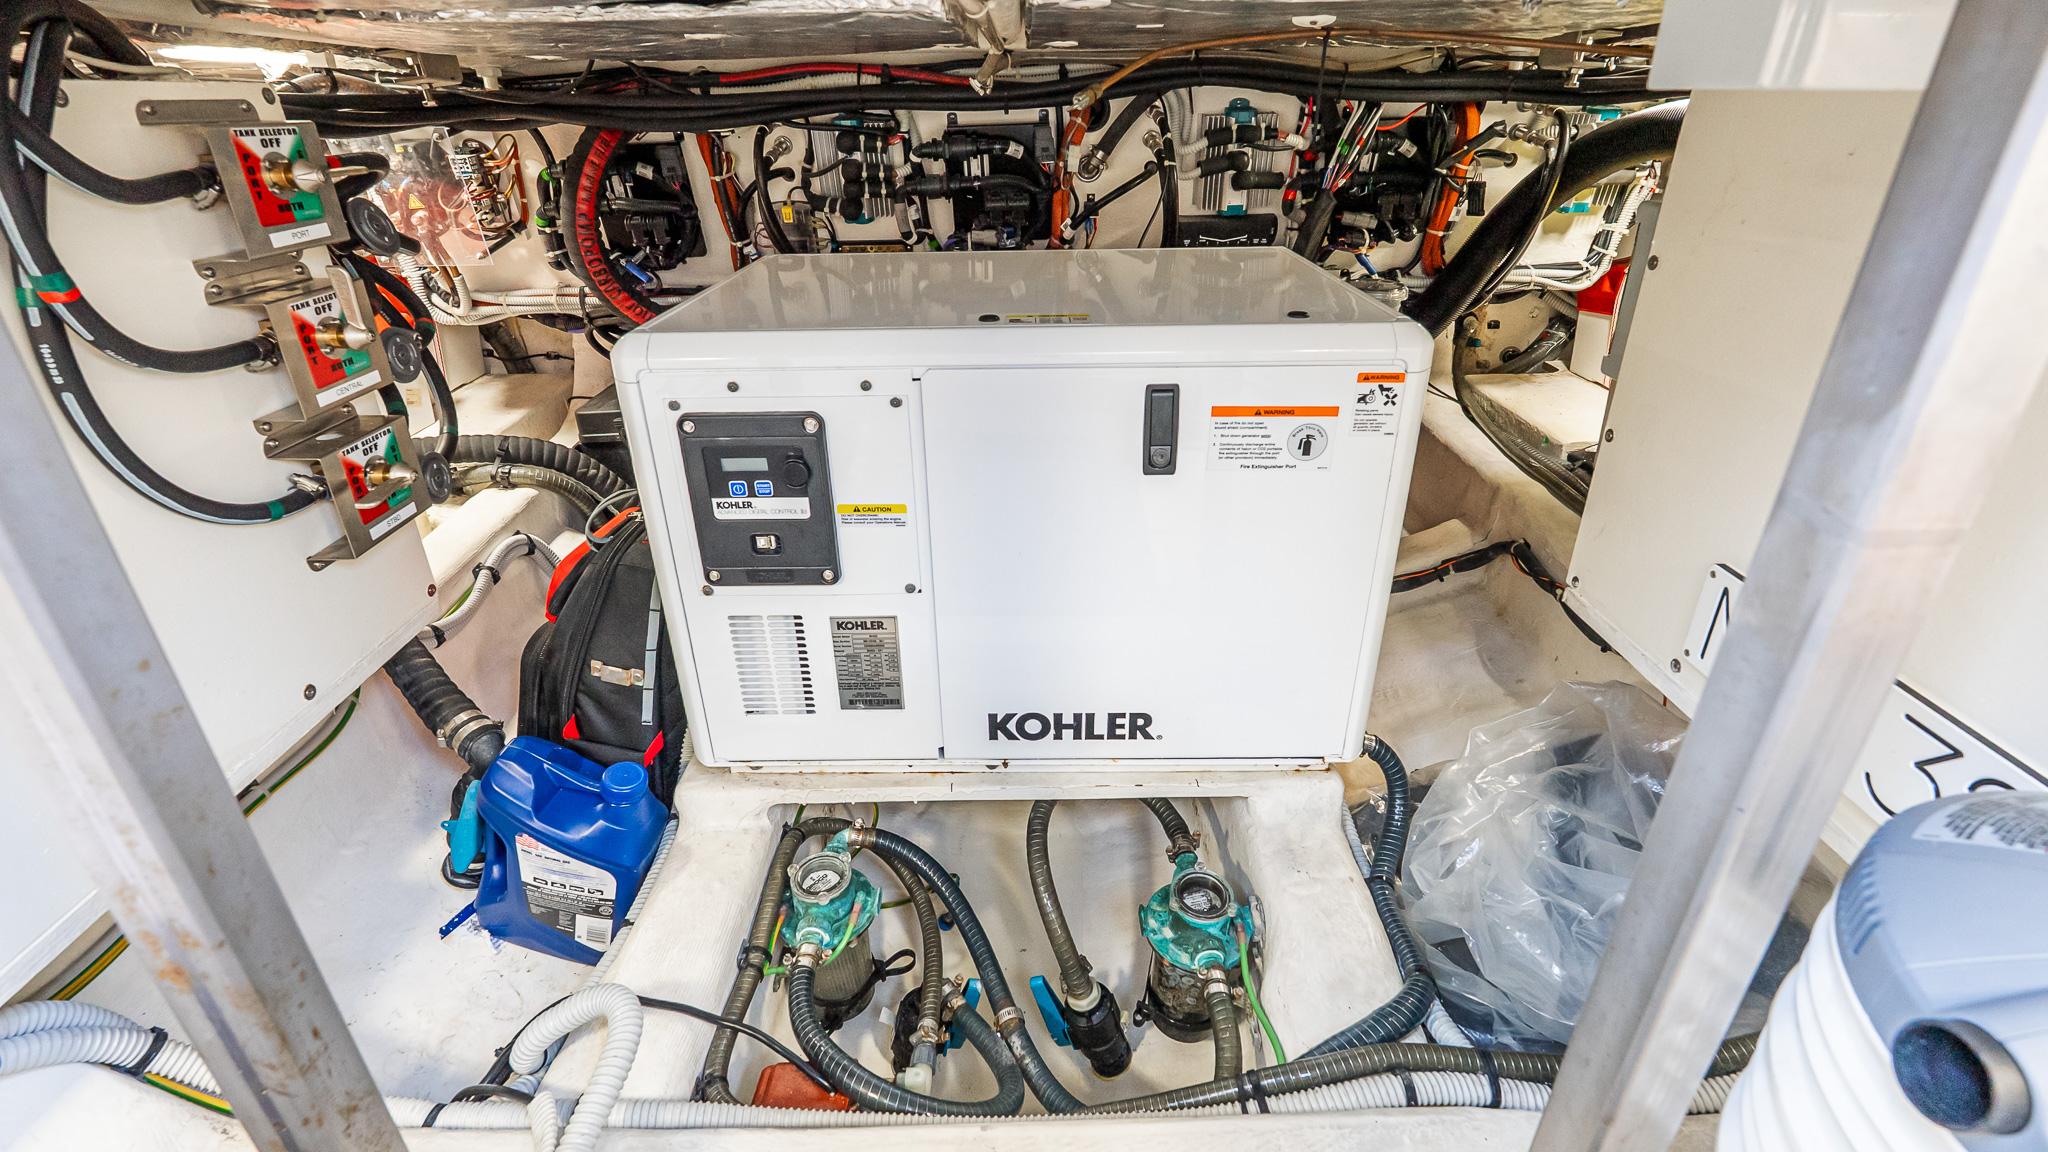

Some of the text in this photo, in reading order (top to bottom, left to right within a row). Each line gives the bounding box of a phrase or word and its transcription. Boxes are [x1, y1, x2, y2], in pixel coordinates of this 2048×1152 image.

[233, 128, 298, 137] TANK SELECTOR
[260, 138, 281, 148] OFF
[243, 153, 262, 200] PORT
[278, 202, 304, 213] BOTH
[291, 229, 310, 240] PORT
[291, 292, 337, 311] TANK SELECT
[314, 303, 332, 315] OFF
[298, 323, 318, 365] PORT
[331, 357, 354, 372] BOTH
[342, 428, 391, 456] TANK SELECTOR
[362, 443, 379, 457] OFF
[716, 501, 754, 510] KOHLER
[836, 620, 885, 631] KOHLER
[988, 712, 1155, 741] KOHLER
